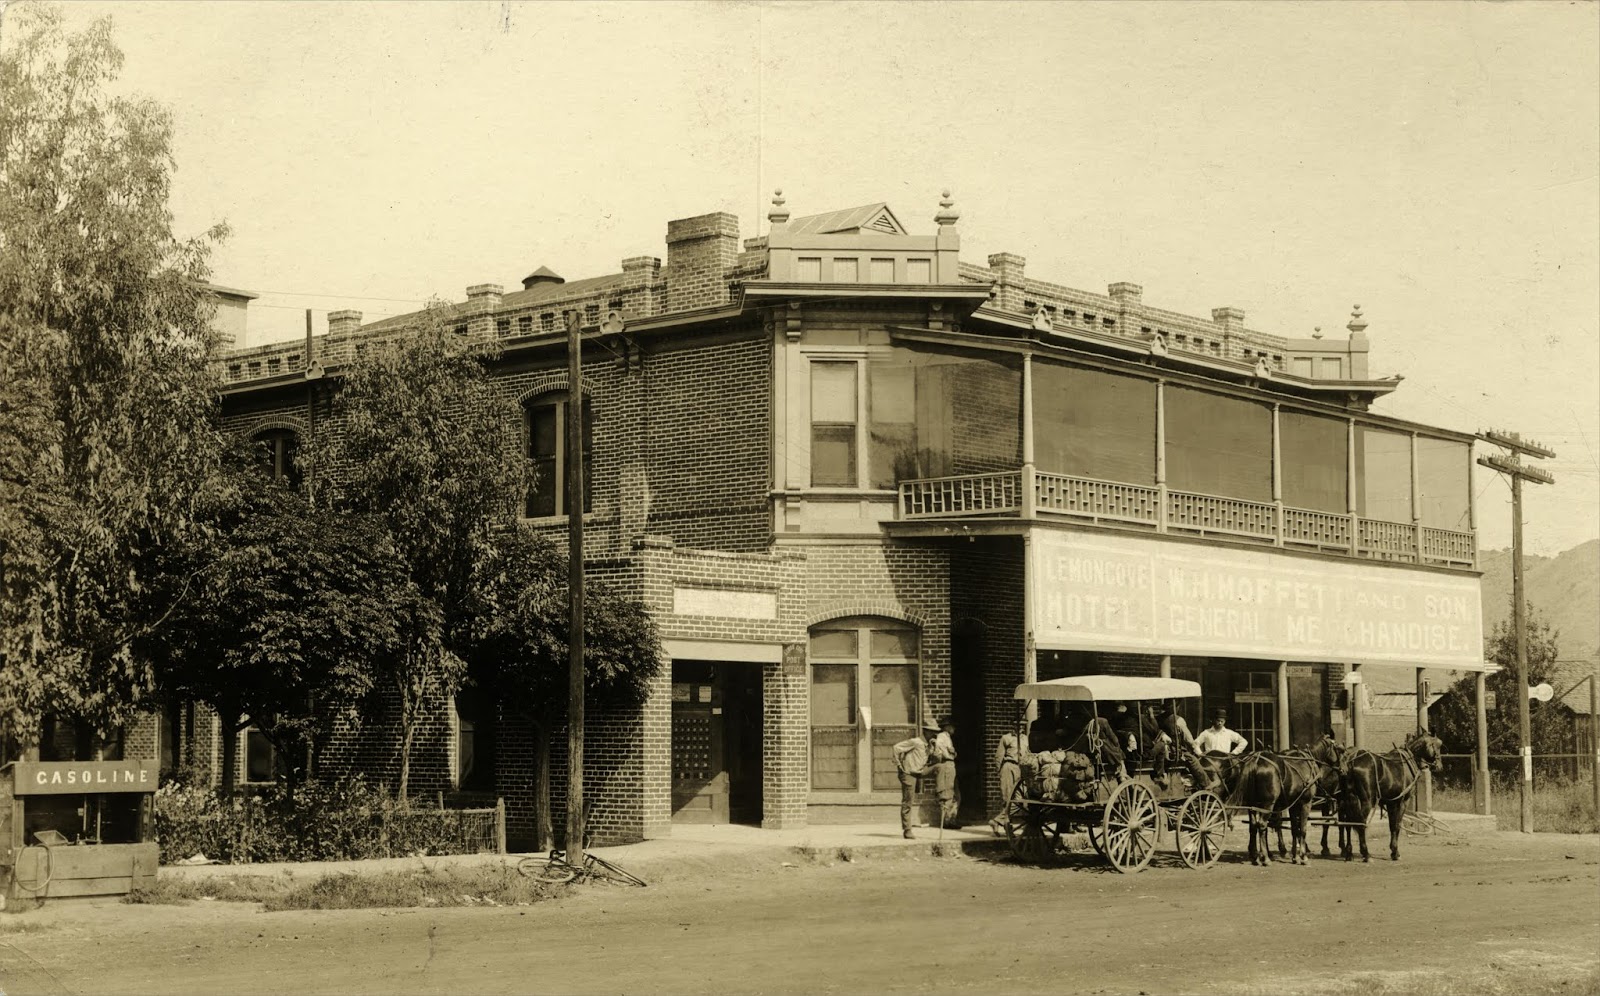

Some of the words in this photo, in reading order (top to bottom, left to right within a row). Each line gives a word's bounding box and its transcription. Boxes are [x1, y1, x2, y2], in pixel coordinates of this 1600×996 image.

[1355, 591, 1406, 610] AND
[1170, 603, 1269, 640] GENERAL
[1286, 614, 1470, 651] MECHANDISE.
[786, 656, 800, 664] POST
[36, 770, 148, 785] GASOLINE
